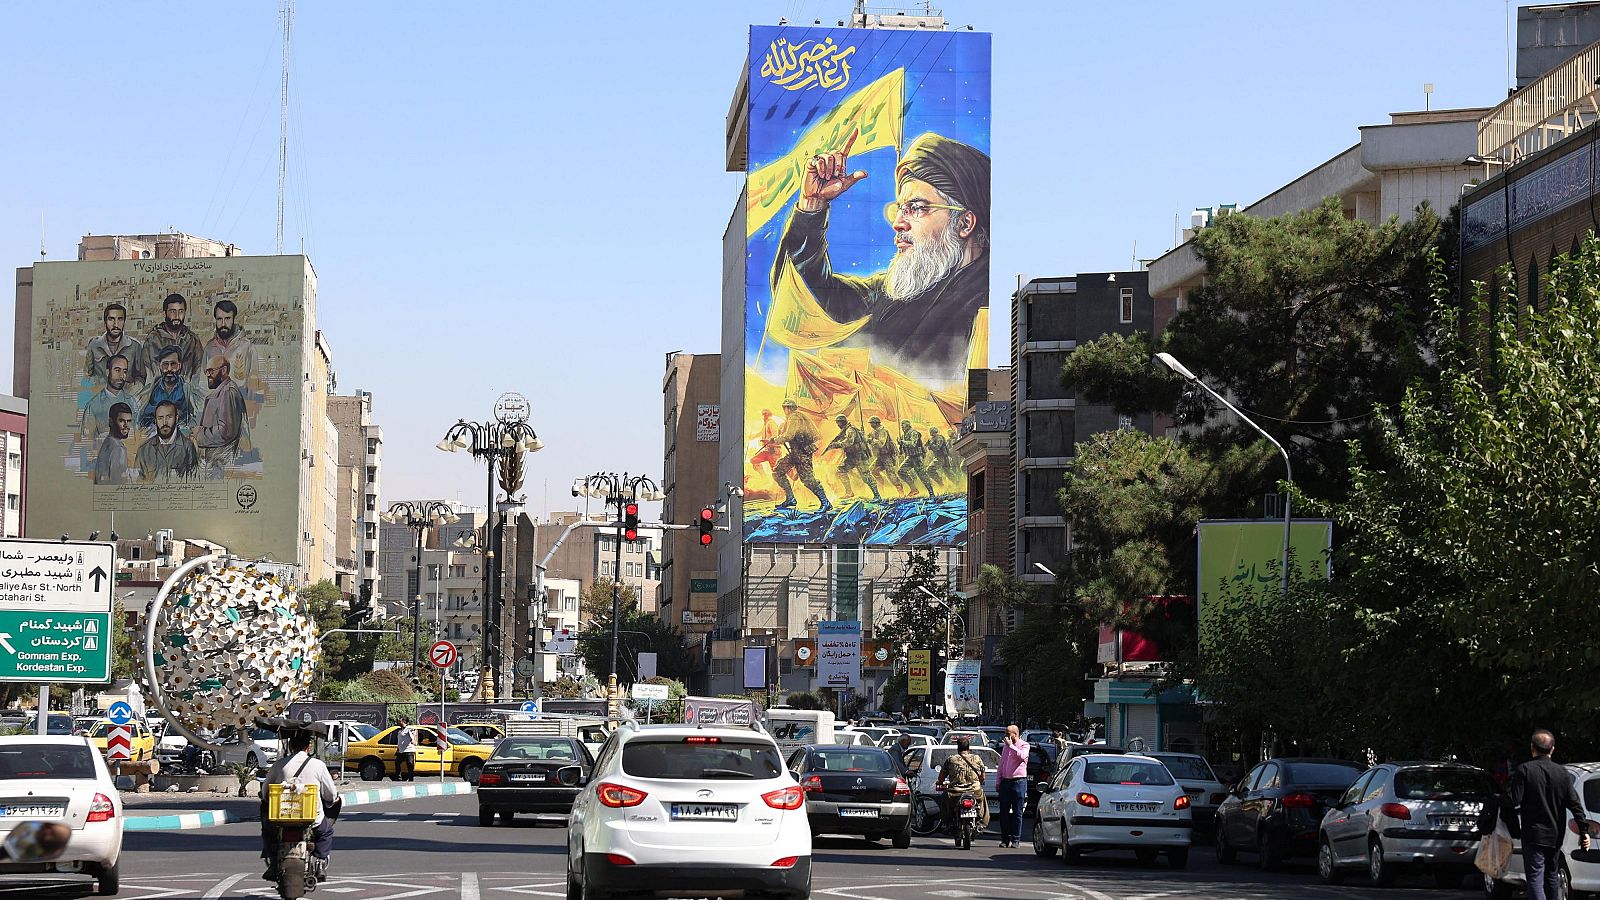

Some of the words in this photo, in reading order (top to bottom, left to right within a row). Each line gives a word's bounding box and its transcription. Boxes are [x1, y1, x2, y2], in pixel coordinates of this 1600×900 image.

[133, 262, 146, 271] ۳۷
[145, 262, 162, 273] اداری
[163, 262, 182, 272] تجاری
[183, 262, 212, 272] ساختمان
[980, 402, 1007, 414] صرافی
[980, 416, 1007, 430] پارسه
[1, 567, 41, 579] مطهری
[44, 568, 73, 579] شهید
[34, 594, 46, 602] St.
[20, 619, 53, 632] گمنام
[53, 619, 83, 632] شهید
[31, 636, 82, 649] کردستان
[822, 640, 839, 650] تخفیف
[17, 652, 59, 660] Gomnam
[61, 652, 82, 662] Exp.
[822, 651, 838, 659] رایگان
[838, 651, 851, 659] حمل
[16, 663, 65, 672] Kordestan
[66, 664, 87, 673] Exp.
